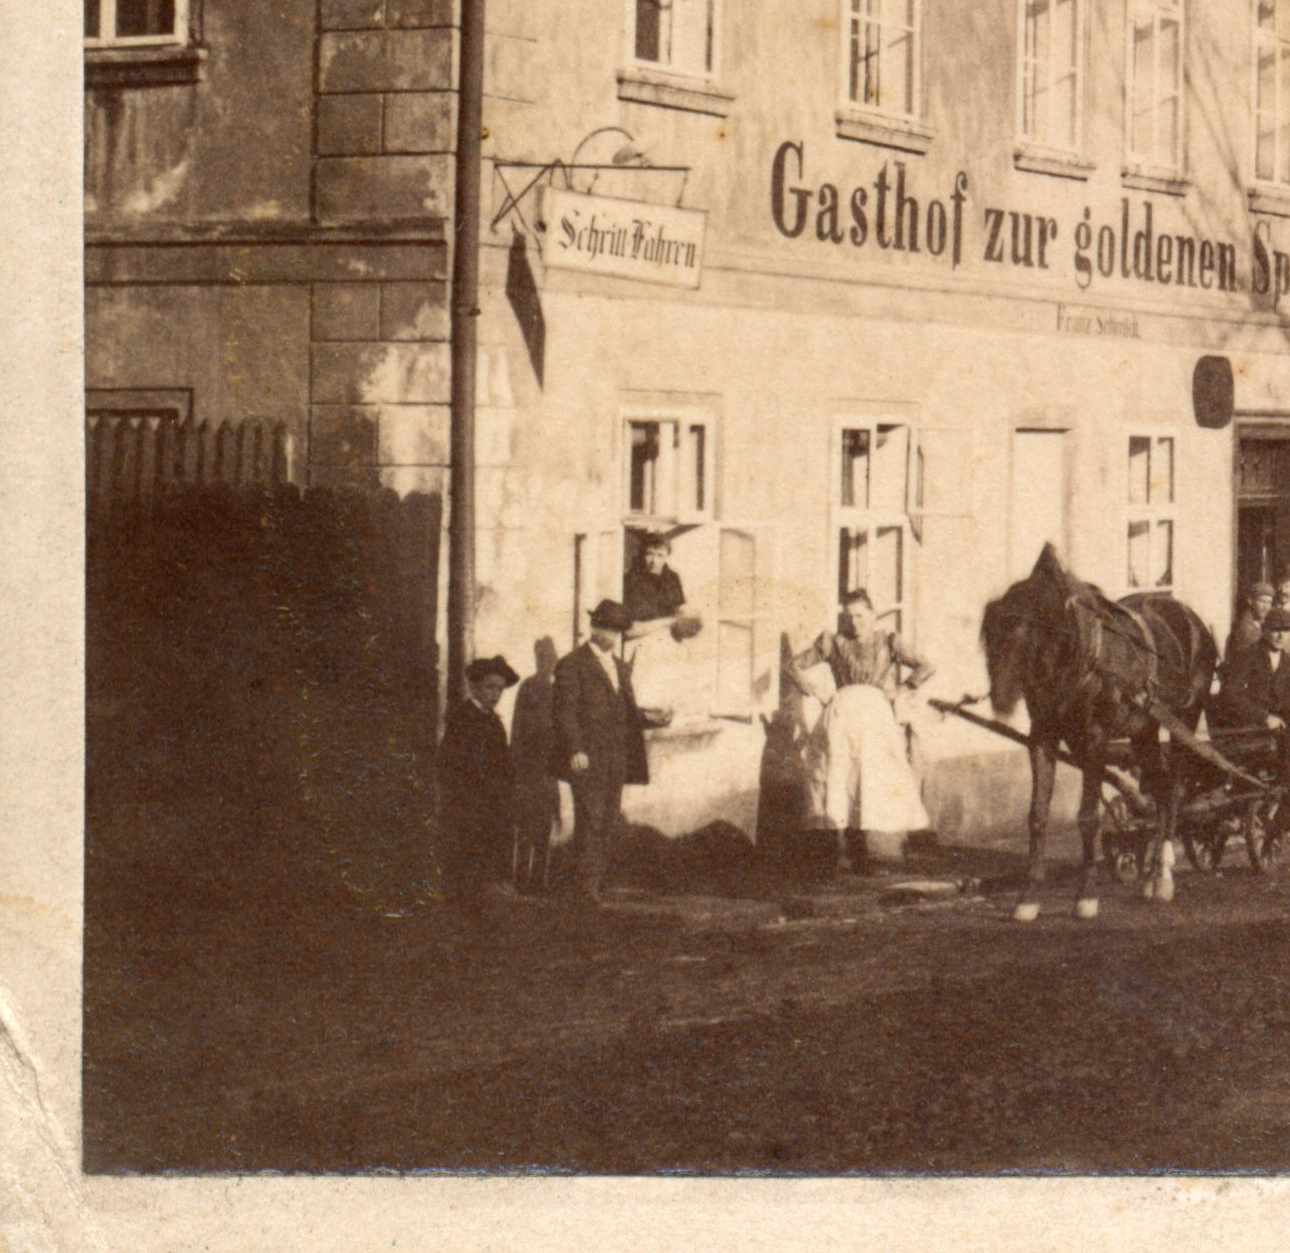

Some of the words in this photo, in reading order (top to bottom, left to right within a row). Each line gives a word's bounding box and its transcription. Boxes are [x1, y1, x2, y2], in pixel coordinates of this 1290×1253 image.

[769, 140, 968, 271] Gasthof
[984, 206, 1058, 270] zur
[1075, 198, 1238, 292] goldenen
